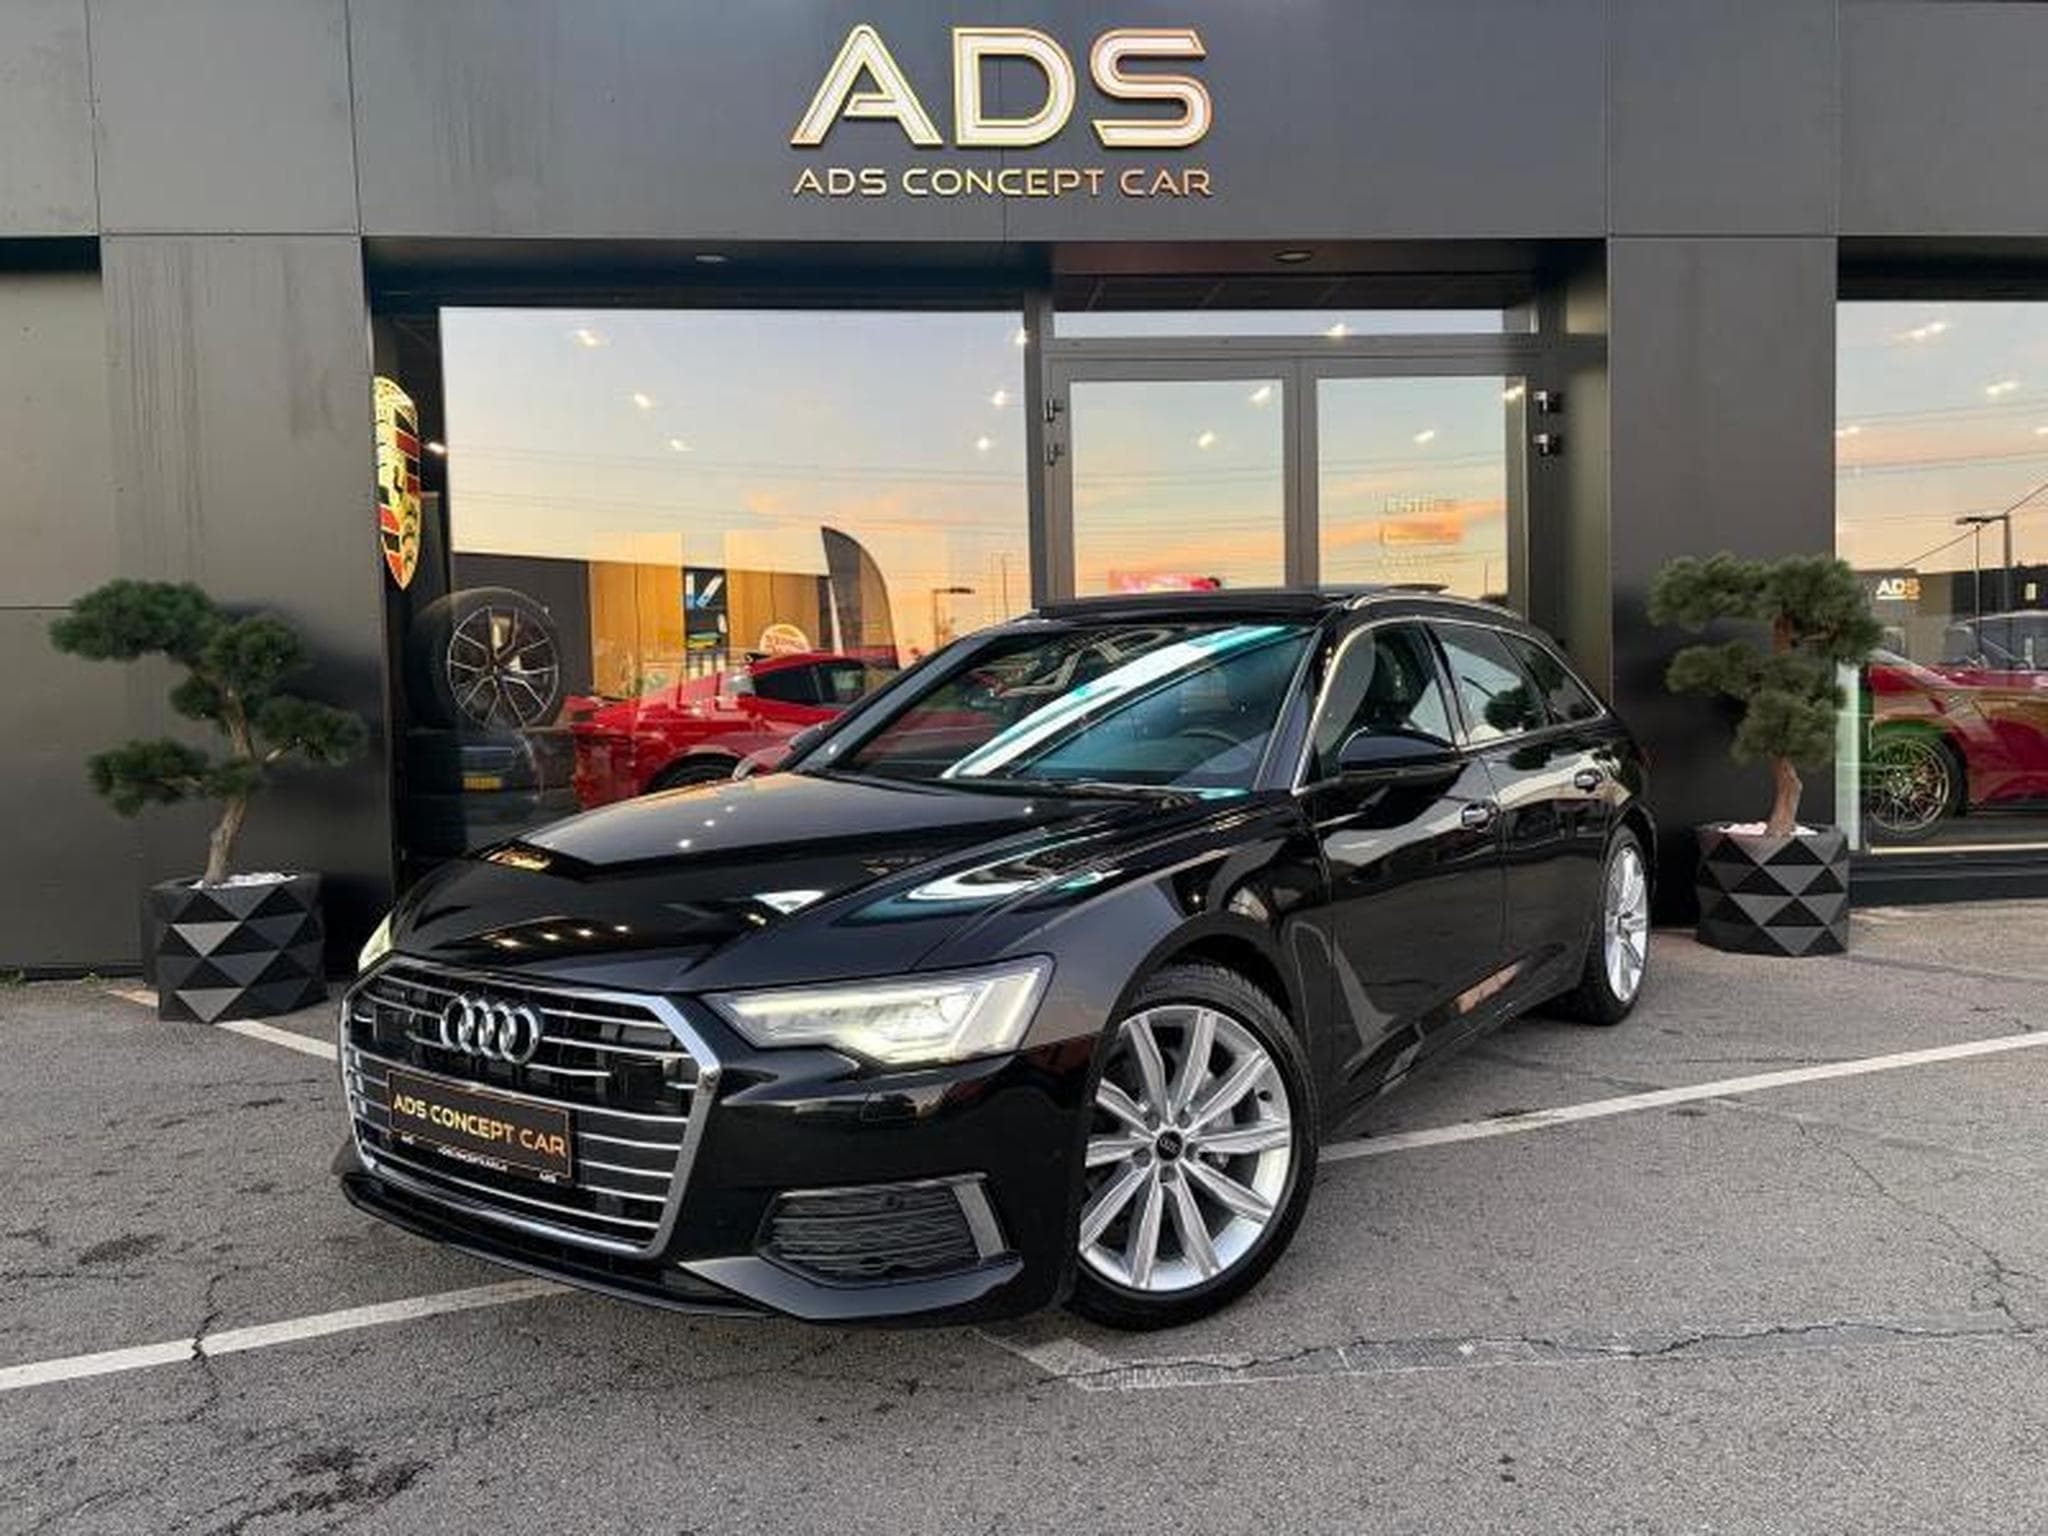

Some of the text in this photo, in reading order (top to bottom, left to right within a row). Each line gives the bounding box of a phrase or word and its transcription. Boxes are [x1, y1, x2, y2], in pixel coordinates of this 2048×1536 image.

[790, 24, 1213, 148] ADS
[793, 168, 1212, 196] ADS CONCEPT CAR
[393, 1093, 567, 1158] ADS CONCEPT CAR
